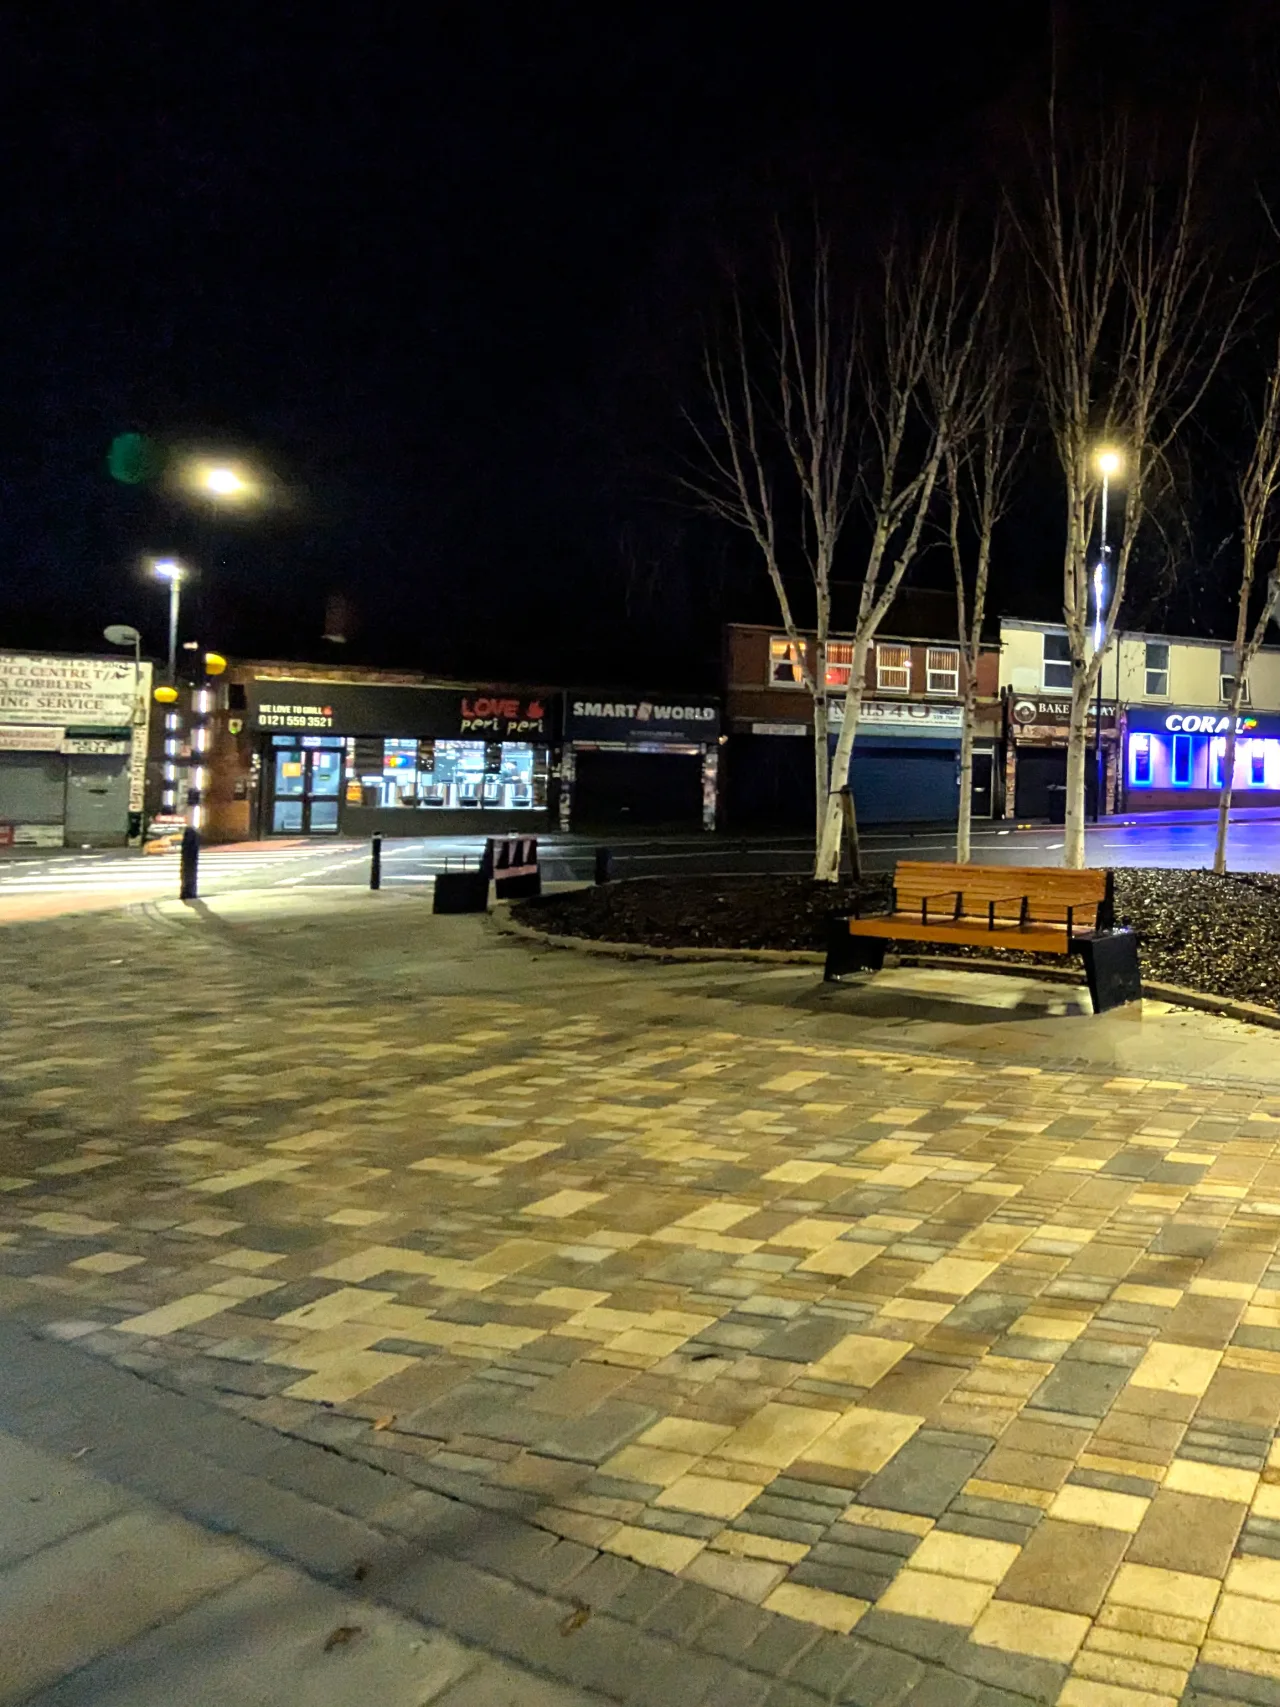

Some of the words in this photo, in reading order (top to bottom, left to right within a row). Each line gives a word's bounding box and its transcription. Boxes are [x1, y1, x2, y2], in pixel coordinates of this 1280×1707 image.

[30, 668, 90, 679] CENTRE
[15, 678, 93, 690] COBBLERS
[37, 698, 103, 710] SERVICE
[259, 704, 273, 713] WE
[273, 704, 291, 714] LOVE
[293, 705, 303, 714] TO
[460, 698, 519, 717] LOVE
[833, 702, 885, 717] NILS
[890, 704, 905, 718] 4
[908, 705, 930, 719] U
[1038, 702, 1071, 714] BAKE
[573, 702, 637, 718] SMART
[654, 705, 716, 721] WORLD
[258, 715, 284, 726] 0121
[286, 715, 306, 727] 559
[307, 716, 333, 728] 3521
[460, 718, 500, 733] peri
[506, 719, 545, 735] peri
[1165, 714, 1245, 734] CORAL
